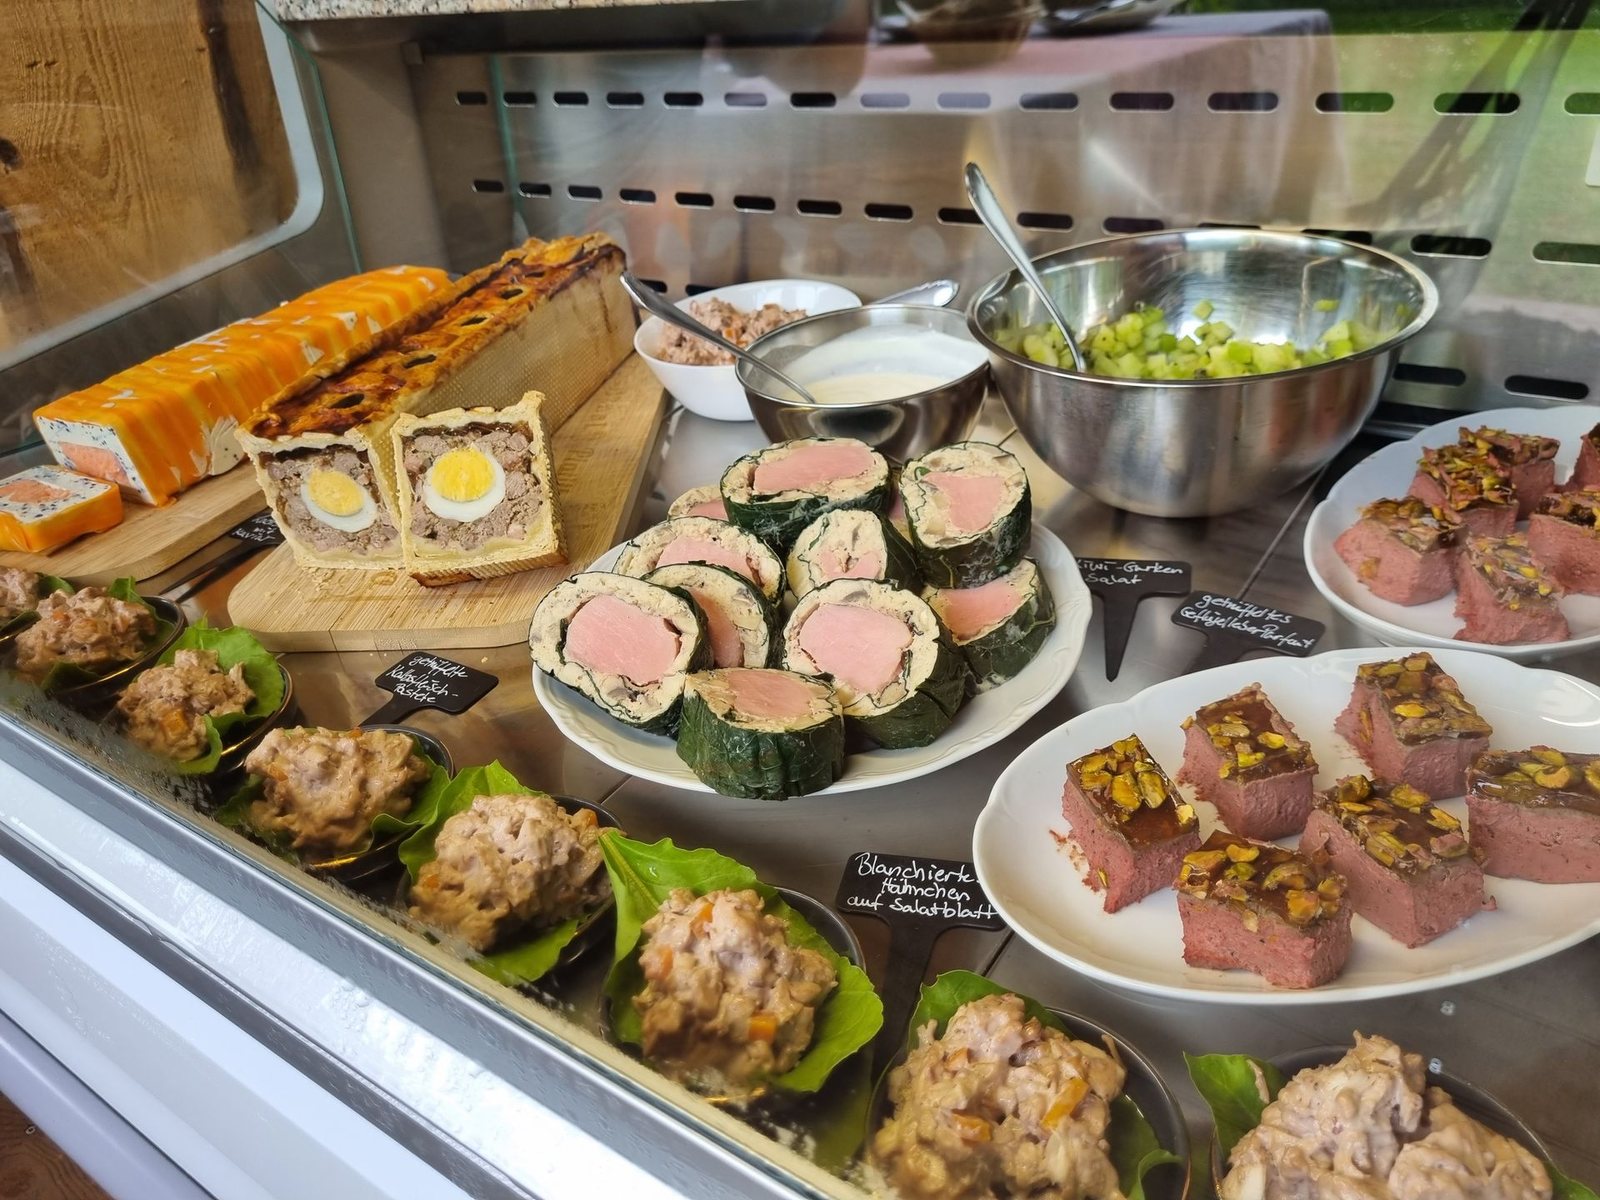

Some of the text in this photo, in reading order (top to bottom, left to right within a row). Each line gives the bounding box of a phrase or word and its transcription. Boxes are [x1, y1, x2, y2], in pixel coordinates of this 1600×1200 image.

[1085, 573, 1142, 585] Salat
[855, 852, 981, 883] Blanchierte
[881, 877, 970, 901] Hähnchen
[846, 893, 1000, 919] auf Salatblatt
